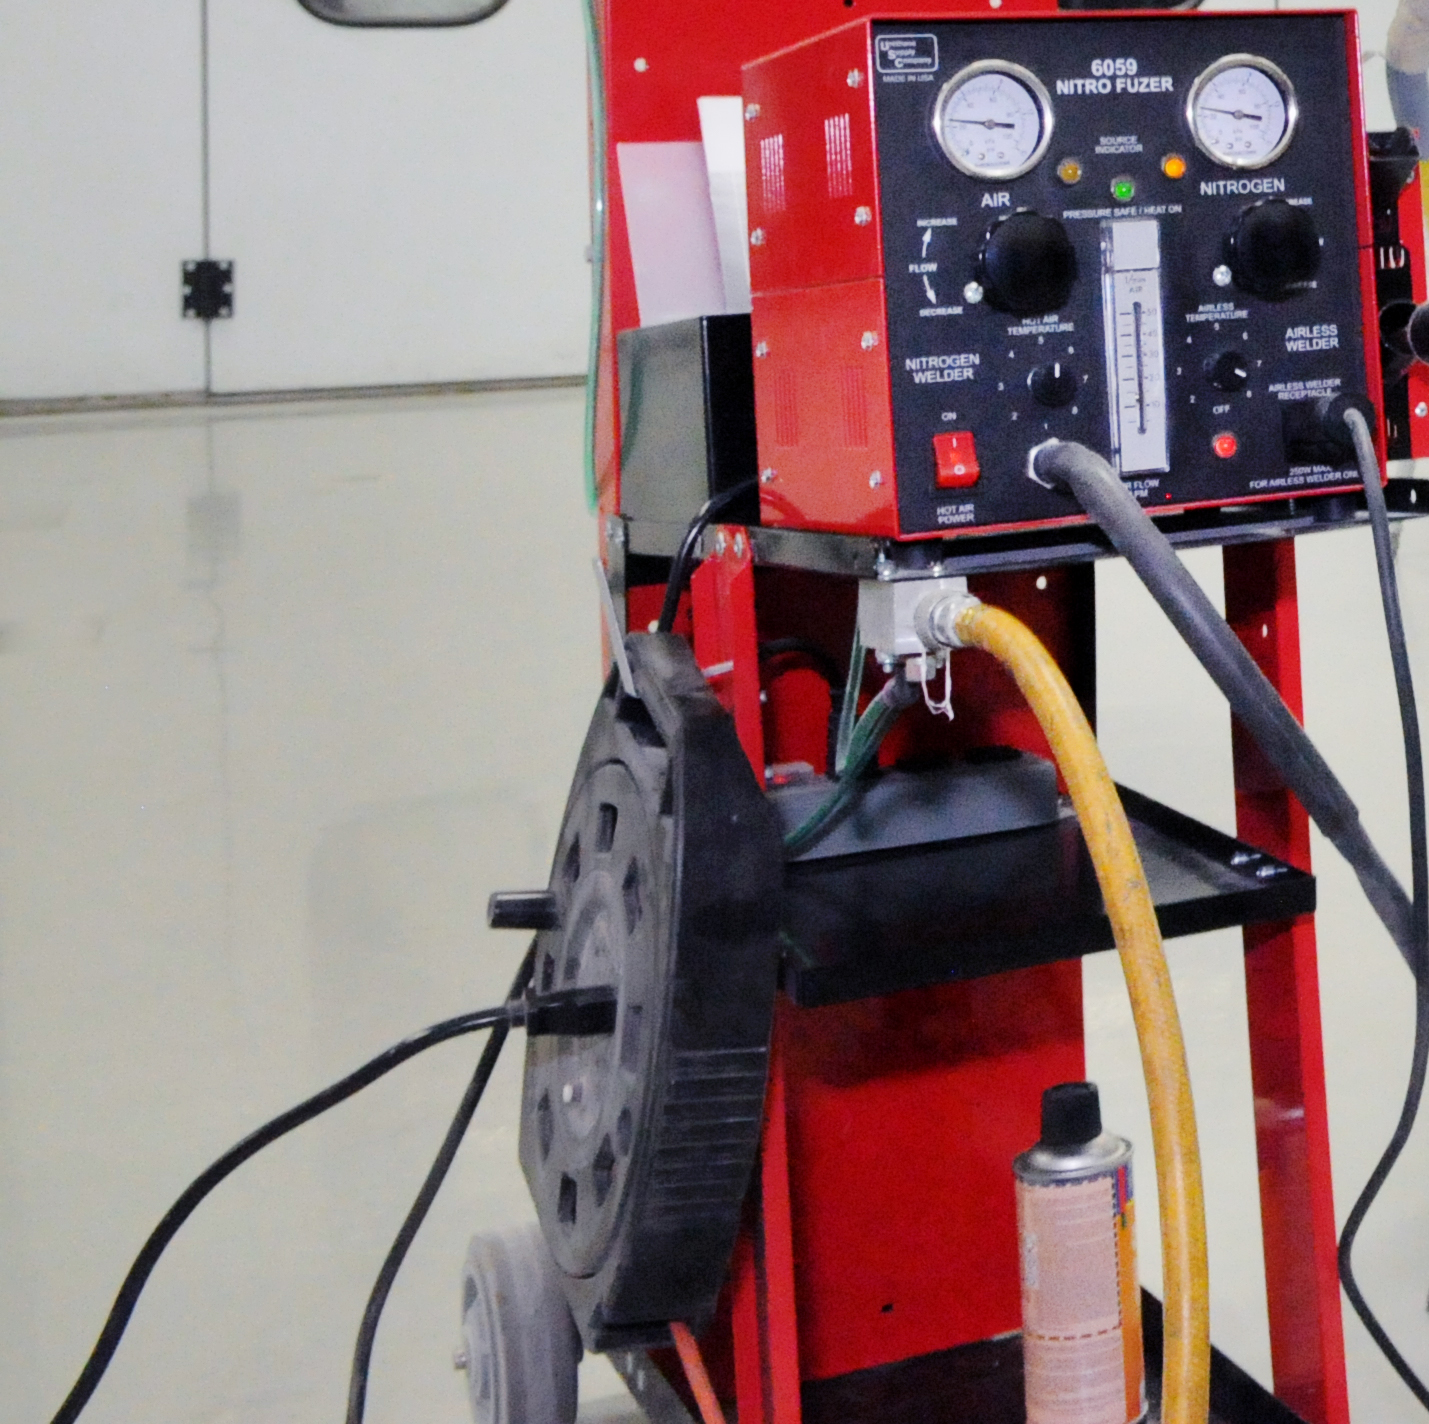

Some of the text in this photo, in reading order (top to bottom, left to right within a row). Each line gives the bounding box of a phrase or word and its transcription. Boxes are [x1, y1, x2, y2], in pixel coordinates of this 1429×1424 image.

[1091, 58, 1138, 76] 6059
[1056, 76, 1174, 95] NITRO FUZER
[1100, 136, 1137, 145] SOURCE
[1095, 144, 1143, 154] INDICATOR
[1200, 178, 1285, 196] NITROGEN
[981, 193, 1010, 207] AIR
[1063, 208, 1111, 218] PRESSURE
[1114, 207, 1137, 216] SAFE
[1144, 206, 1166, 215] HEAT
[1168, 205, 1182, 214] ON
[917, 218, 958, 227] INCREASE
[909, 263, 937, 273] FLOW
[919, 306, 963, 317] DECREASE
[1198, 302, 1234, 312] AIRLESS
[1043, 314, 1059, 324] AIR
[1185, 310, 1248, 323] TEMPERATURE
[1007, 322, 1074, 336] TEMPERATURE
[1285, 324, 1338, 339] AIRLESS
[1286, 337, 1339, 352] WELDER
[905, 353, 980, 371] NITROGEN
[913, 367, 974, 384] WELDER
[1268, 378, 1341, 392] AIRLESS WELDER
[1278, 388, 1332, 400] RECEPTACLE
[1213, 404, 1230, 414] OFF
[941, 412, 956, 421] ON
[1134, 479, 1160, 488] FLOW
[1250, 480, 1268, 489] FOR
[1268, 476, 1303, 488] AIRLESS
[1306, 472, 1342, 485] WELDER
[937, 504, 974, 516] HOT AIR
[938, 512, 974, 524] POWER
